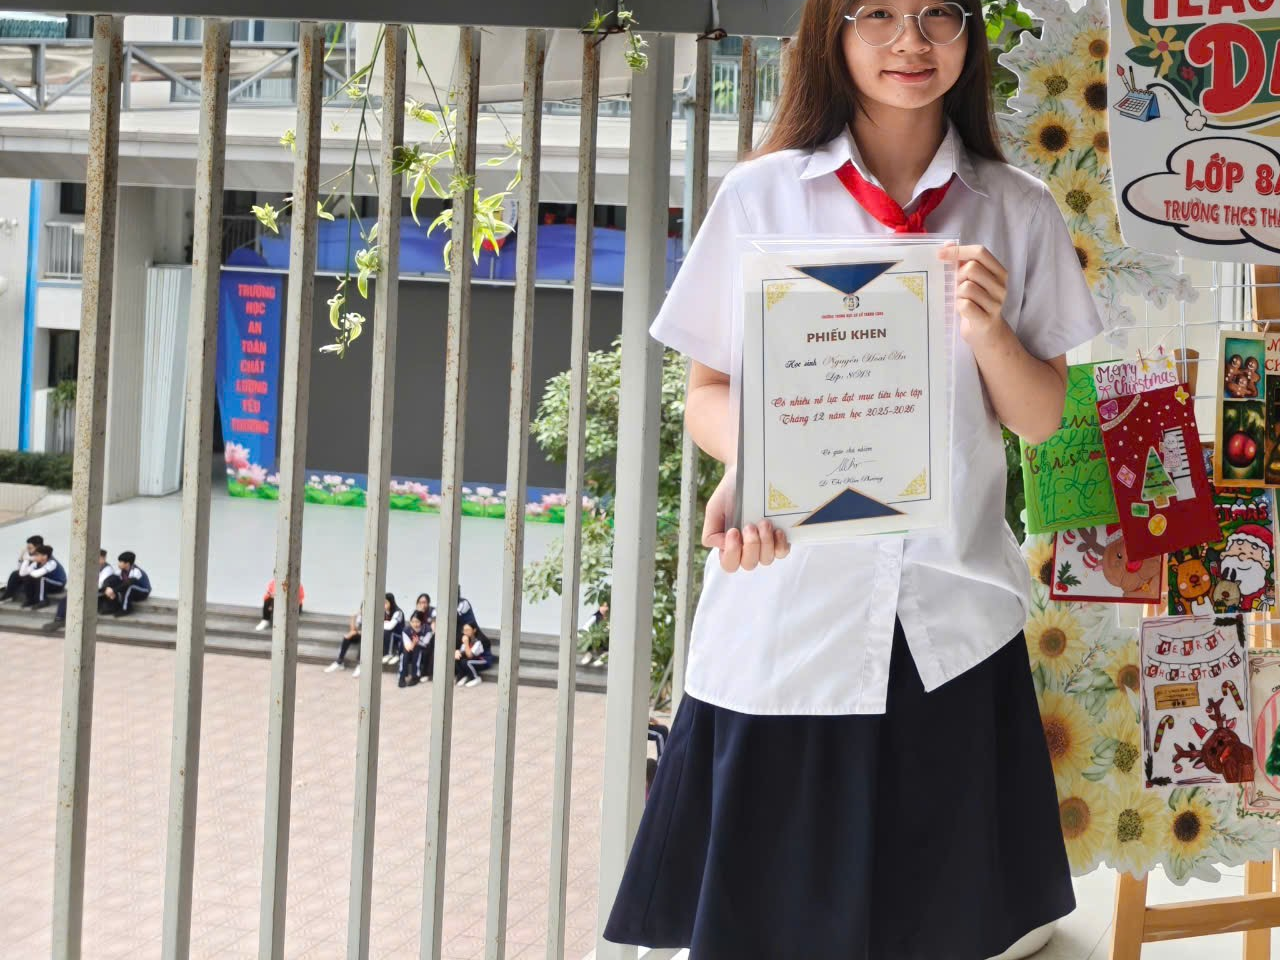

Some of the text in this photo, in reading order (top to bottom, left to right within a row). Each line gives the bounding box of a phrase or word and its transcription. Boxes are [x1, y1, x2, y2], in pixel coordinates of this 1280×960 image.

[1185, 152, 1244, 193] LỚP
[1164, 198, 1220, 224] TRƯỜNG
[1223, 205, 1257, 227] THCS
[247, 320, 262, 335] AN
[807, 327, 887, 343] PHIẾU KHEN
[1096, 363, 1137, 384] Merry
[813, 412, 825, 421] 12
[1160, 630, 1225, 654] MERRY
